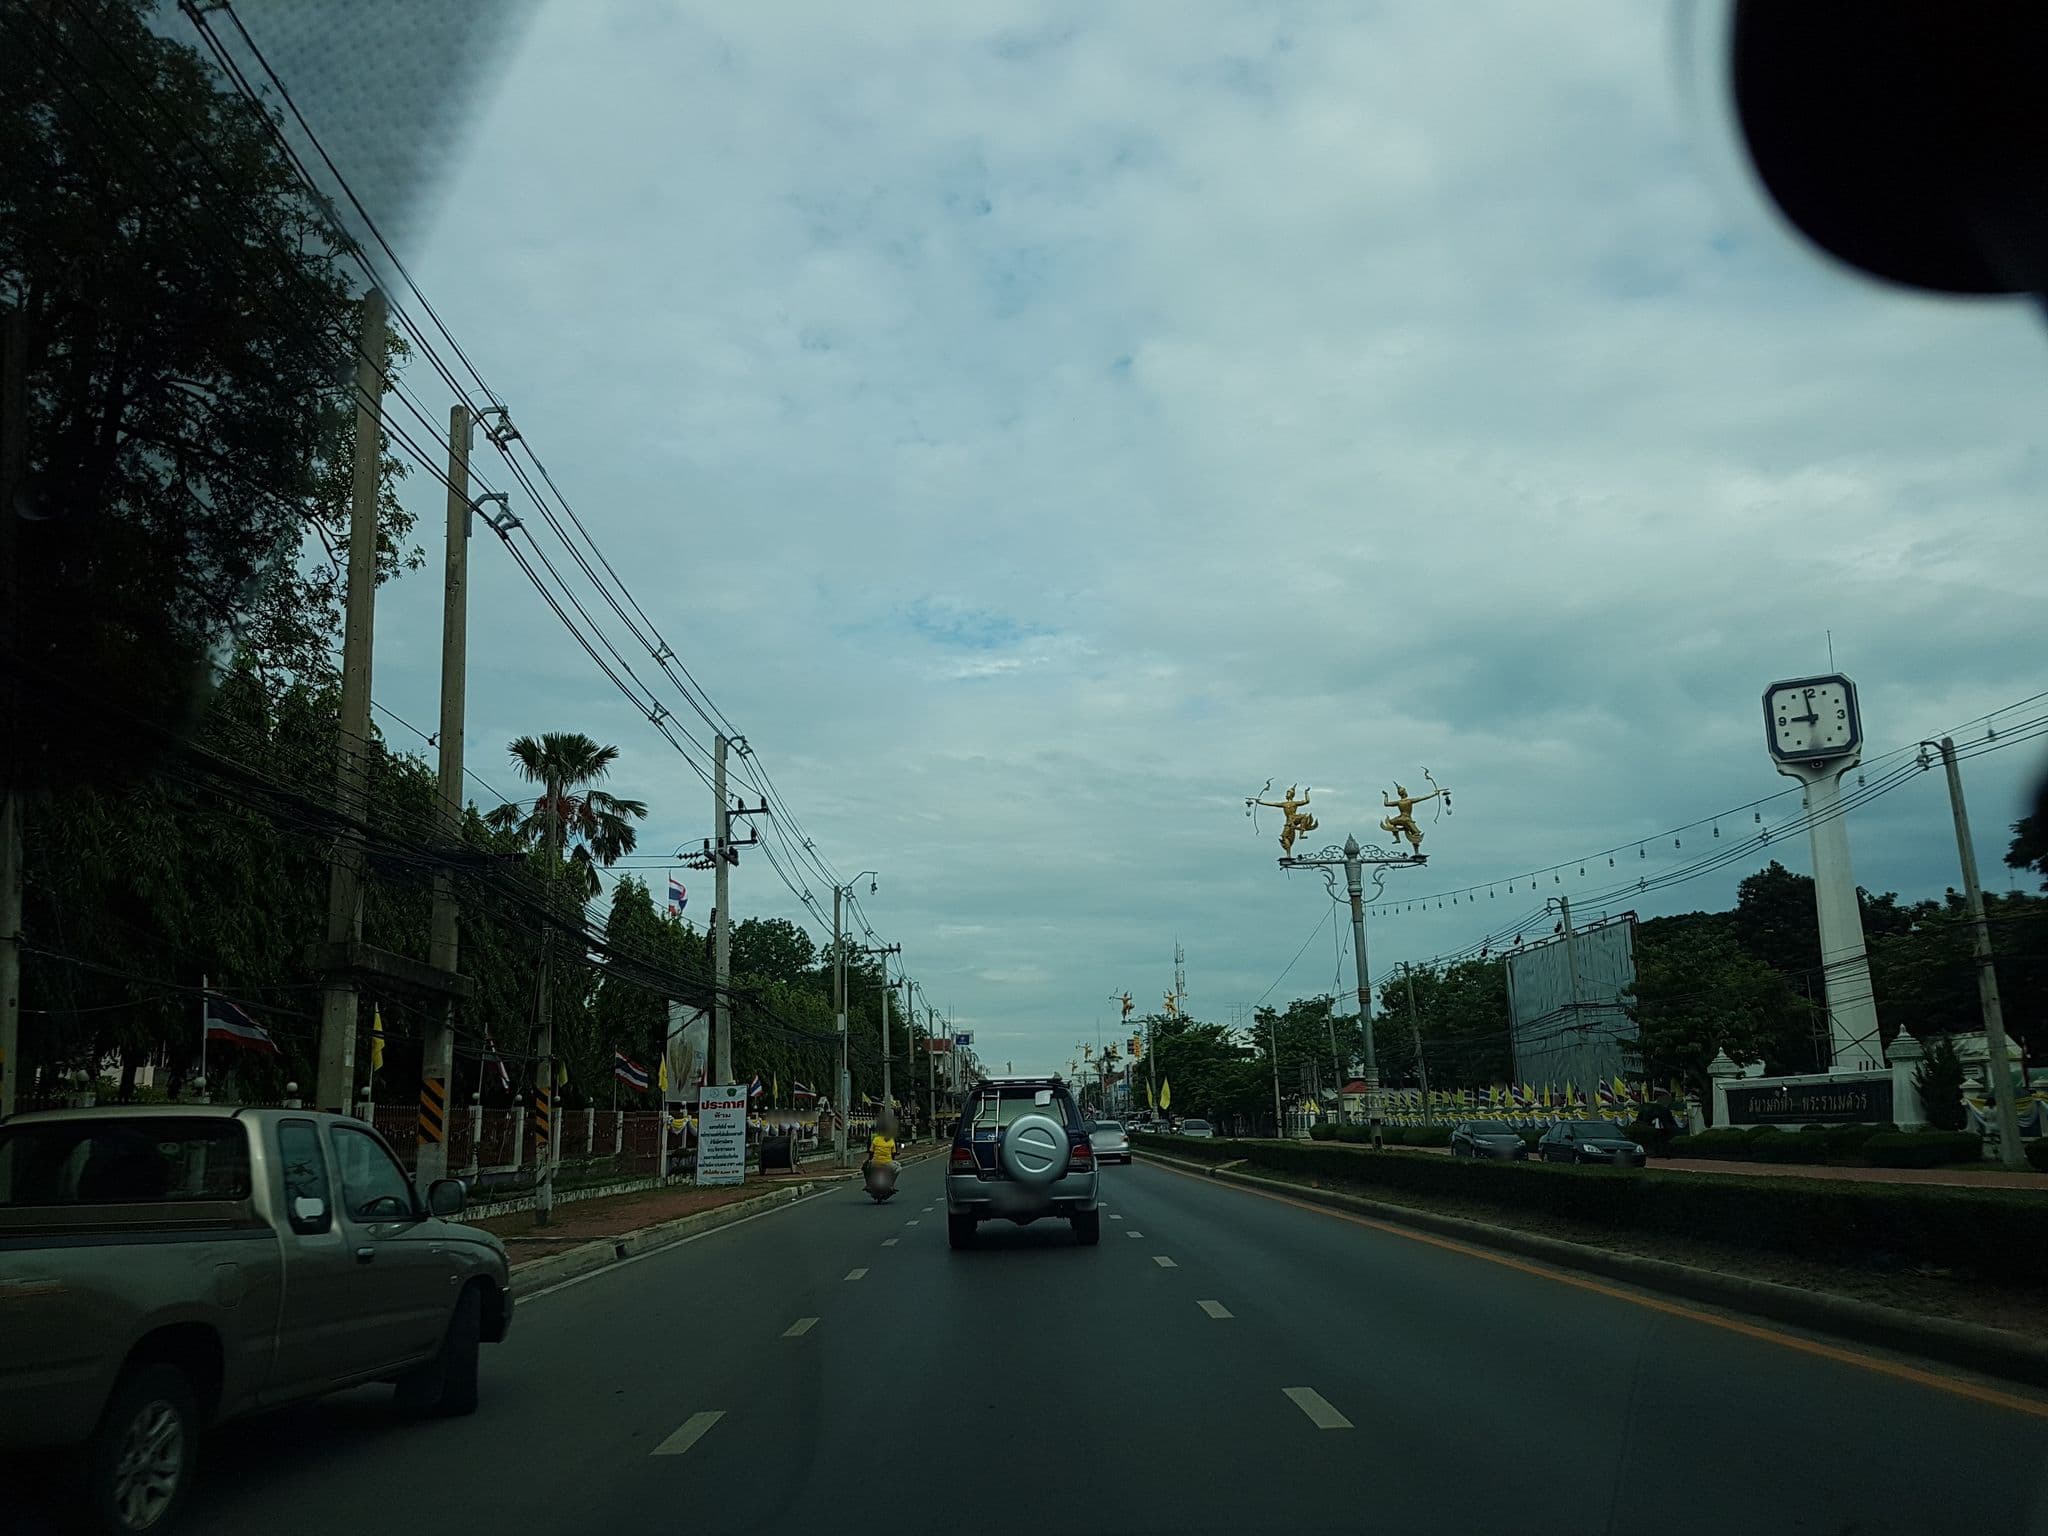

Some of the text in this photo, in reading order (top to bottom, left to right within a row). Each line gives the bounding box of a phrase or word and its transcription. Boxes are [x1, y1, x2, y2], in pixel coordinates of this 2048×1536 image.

[1836, 709, 1846, 719] 3
[1778, 716, 1787, 726] 9
[702, 1100, 744, 1110] ประกาศ
